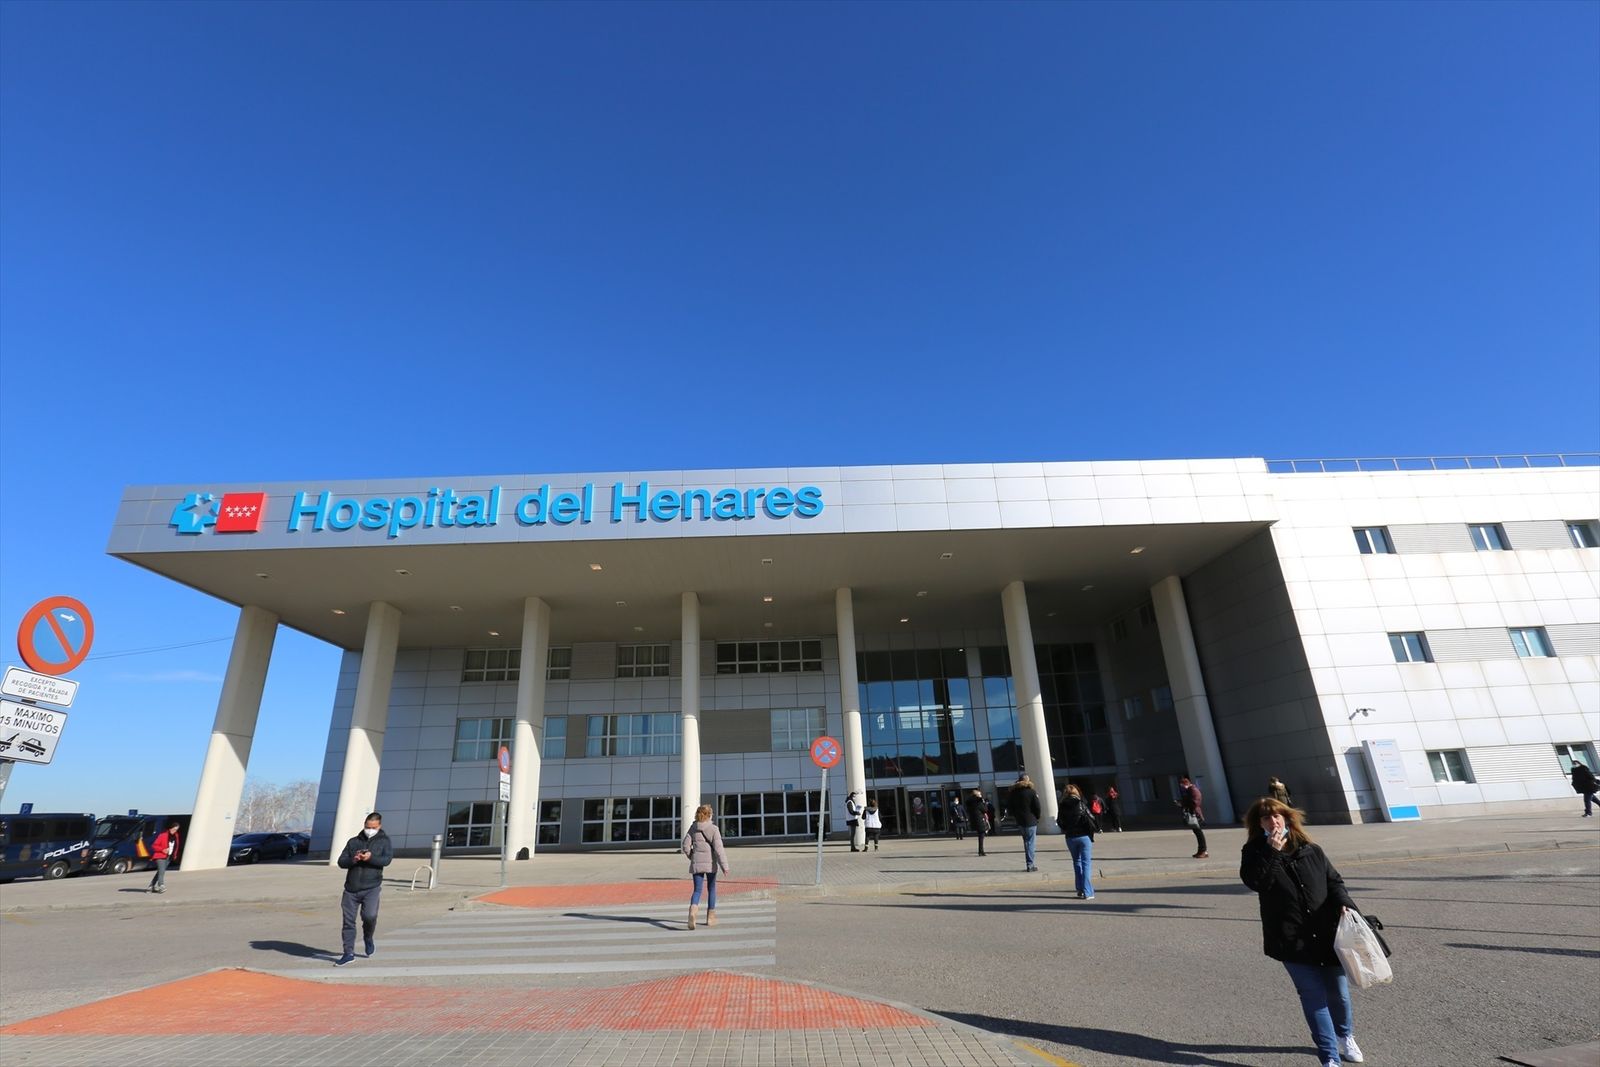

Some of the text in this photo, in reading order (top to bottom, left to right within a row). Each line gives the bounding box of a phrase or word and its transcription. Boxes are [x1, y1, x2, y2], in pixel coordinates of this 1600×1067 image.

[288, 481, 825, 538] Hospital del Henares
[12, 679, 41, 690] RECOGIDA
[48, 687, 69, 696] BAJADA
[30, 676, 56, 687] EXCEPTO
[28, 688, 59, 700] PACIENTES
[14, 707, 54, 723] MAXIMO
[0, 715, 59, 734] 15 MINUTOS
[43, 840, 90, 860] POLICÍA
